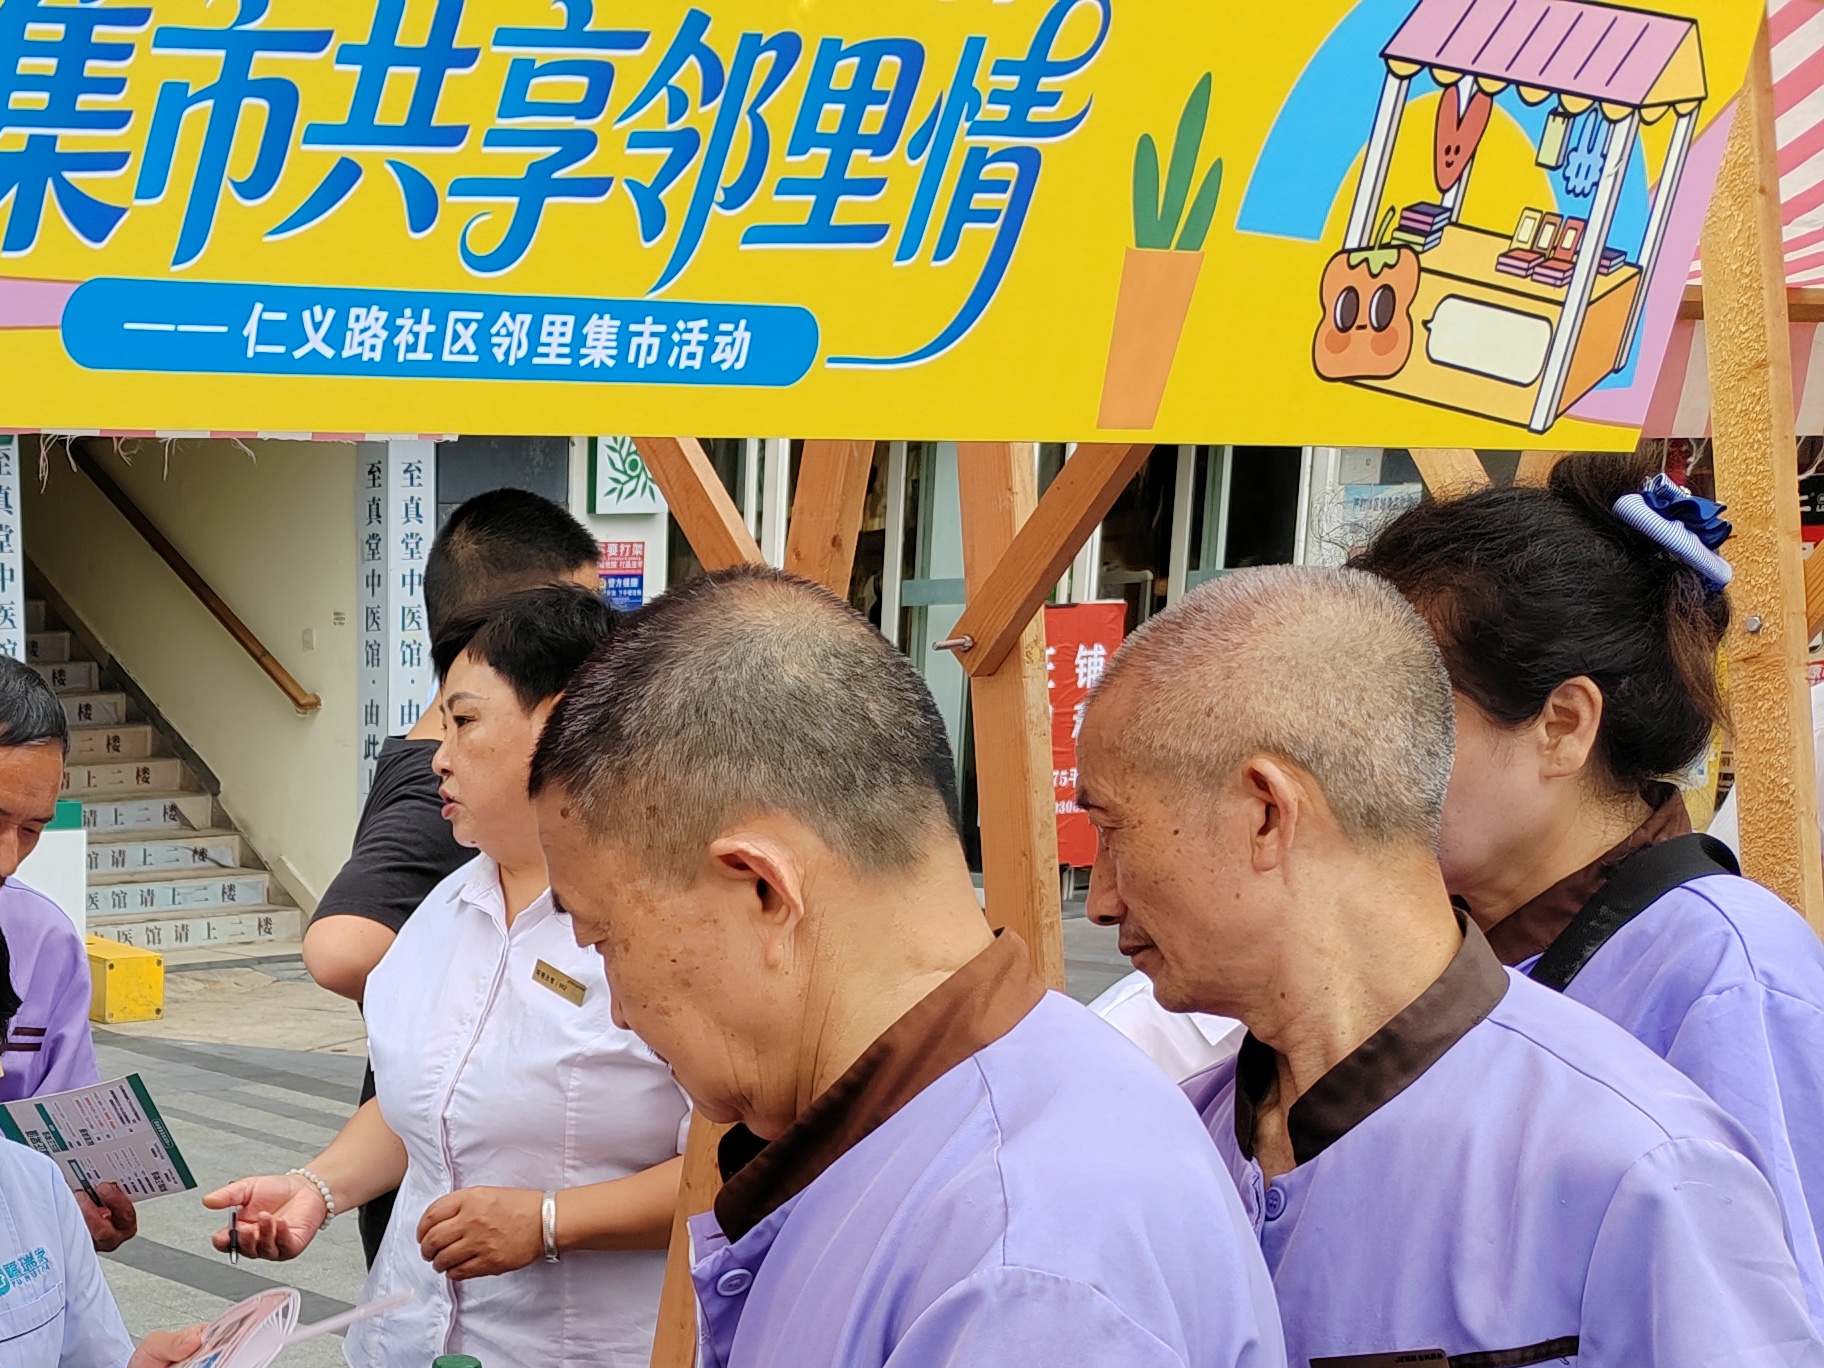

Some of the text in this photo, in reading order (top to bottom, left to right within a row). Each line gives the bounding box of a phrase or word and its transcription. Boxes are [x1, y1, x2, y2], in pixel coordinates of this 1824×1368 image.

[80, 733, 121, 753] 二楼
[82, 803, 180, 828] 请上二楼
